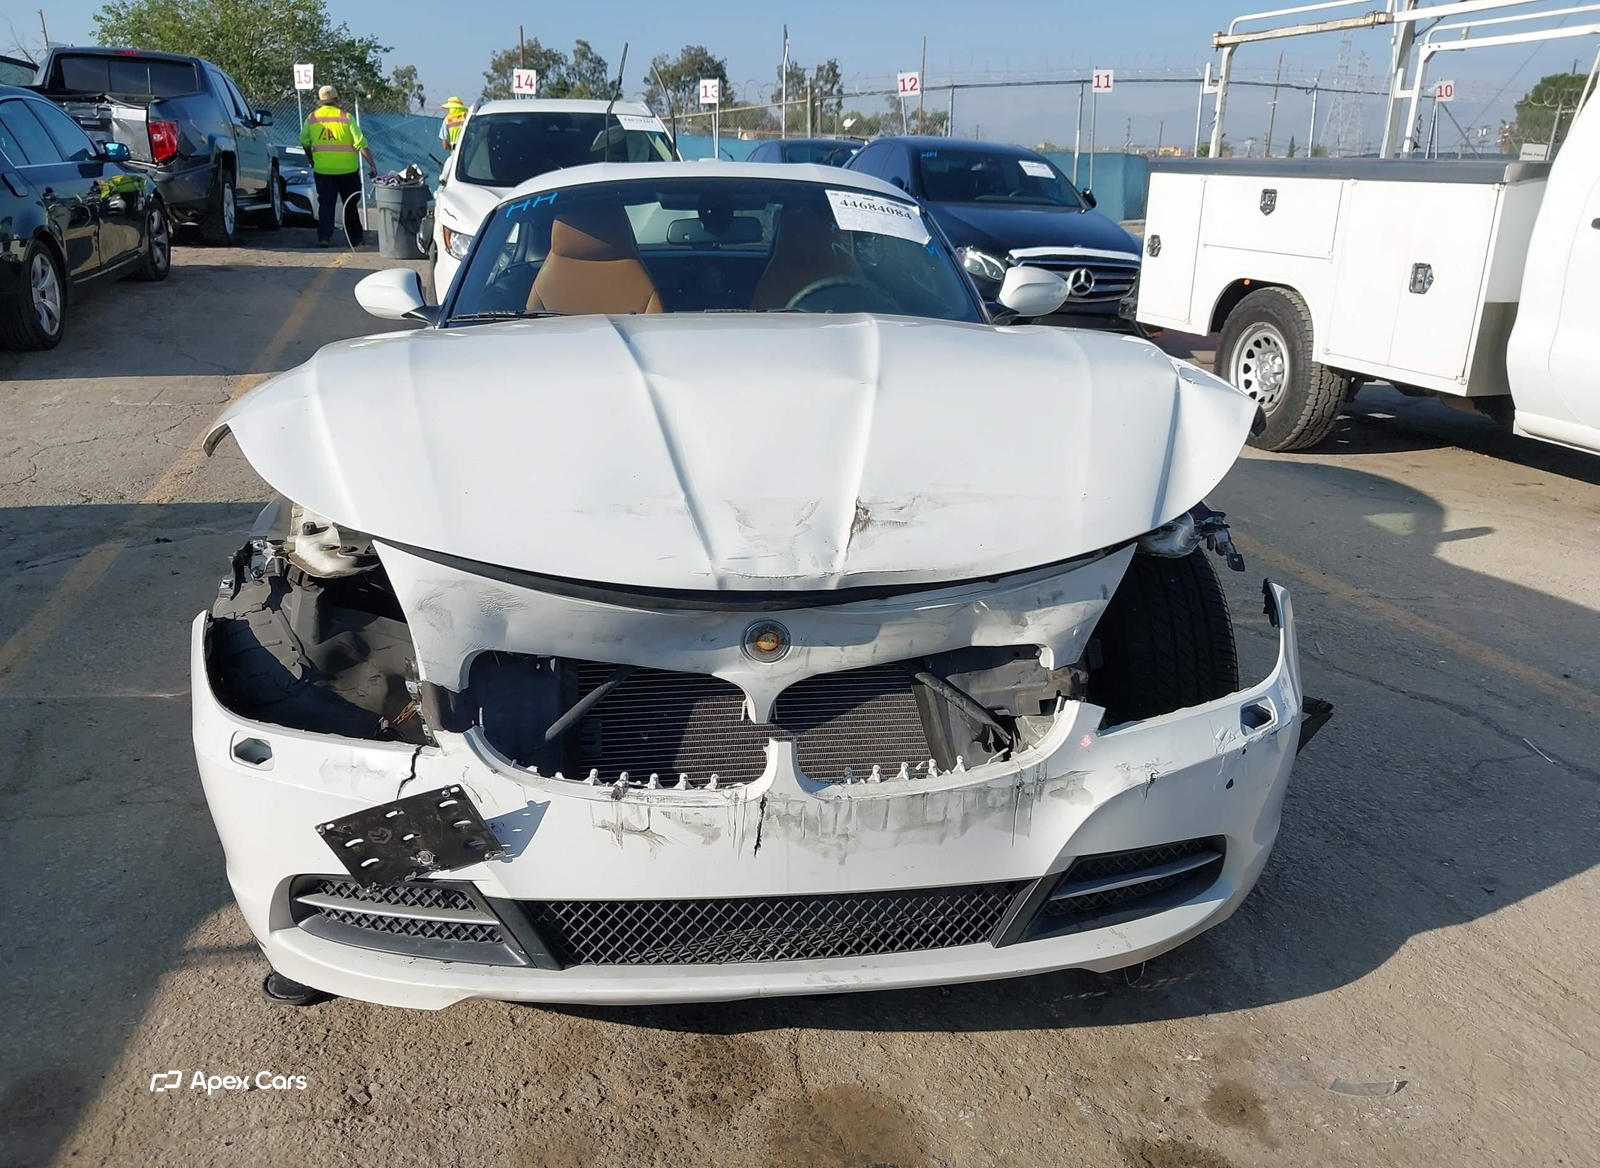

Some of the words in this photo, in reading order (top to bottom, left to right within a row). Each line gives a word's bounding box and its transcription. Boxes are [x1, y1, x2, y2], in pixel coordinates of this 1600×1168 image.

[295, 69, 311, 84] 15
[515, 74, 534, 89] 14
[1094, 74, 1111, 88] 11
[702, 84, 718, 98] 13
[899, 77, 918, 93] 12
[1437, 84, 1453, 98] 10
[840, 199, 912, 220] 44684084
